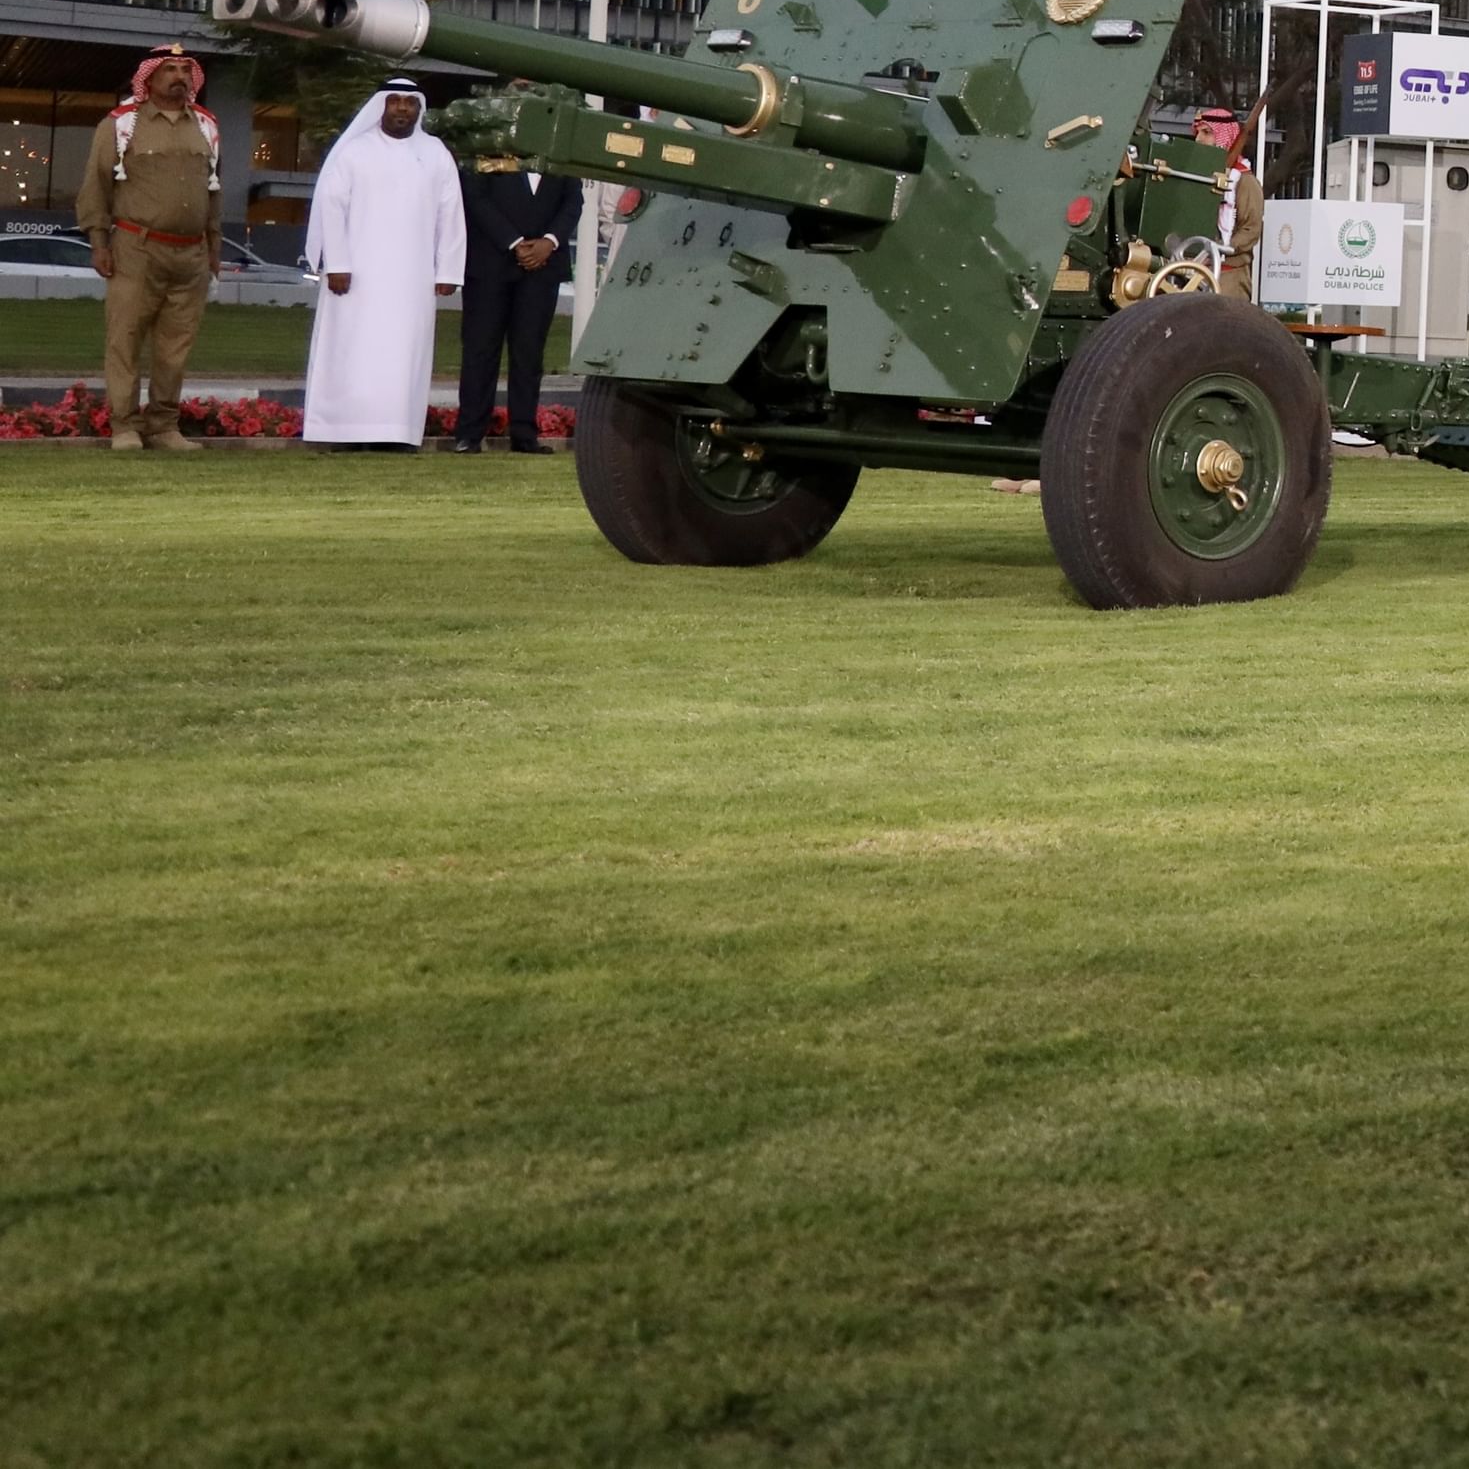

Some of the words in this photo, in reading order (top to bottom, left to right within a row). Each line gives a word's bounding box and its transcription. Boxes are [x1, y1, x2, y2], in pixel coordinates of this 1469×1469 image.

[1352, 264, 1385, 282] شرطة
[1324, 281, 1351, 290] DUBAI
[1353, 282, 1385, 291] POLICE
